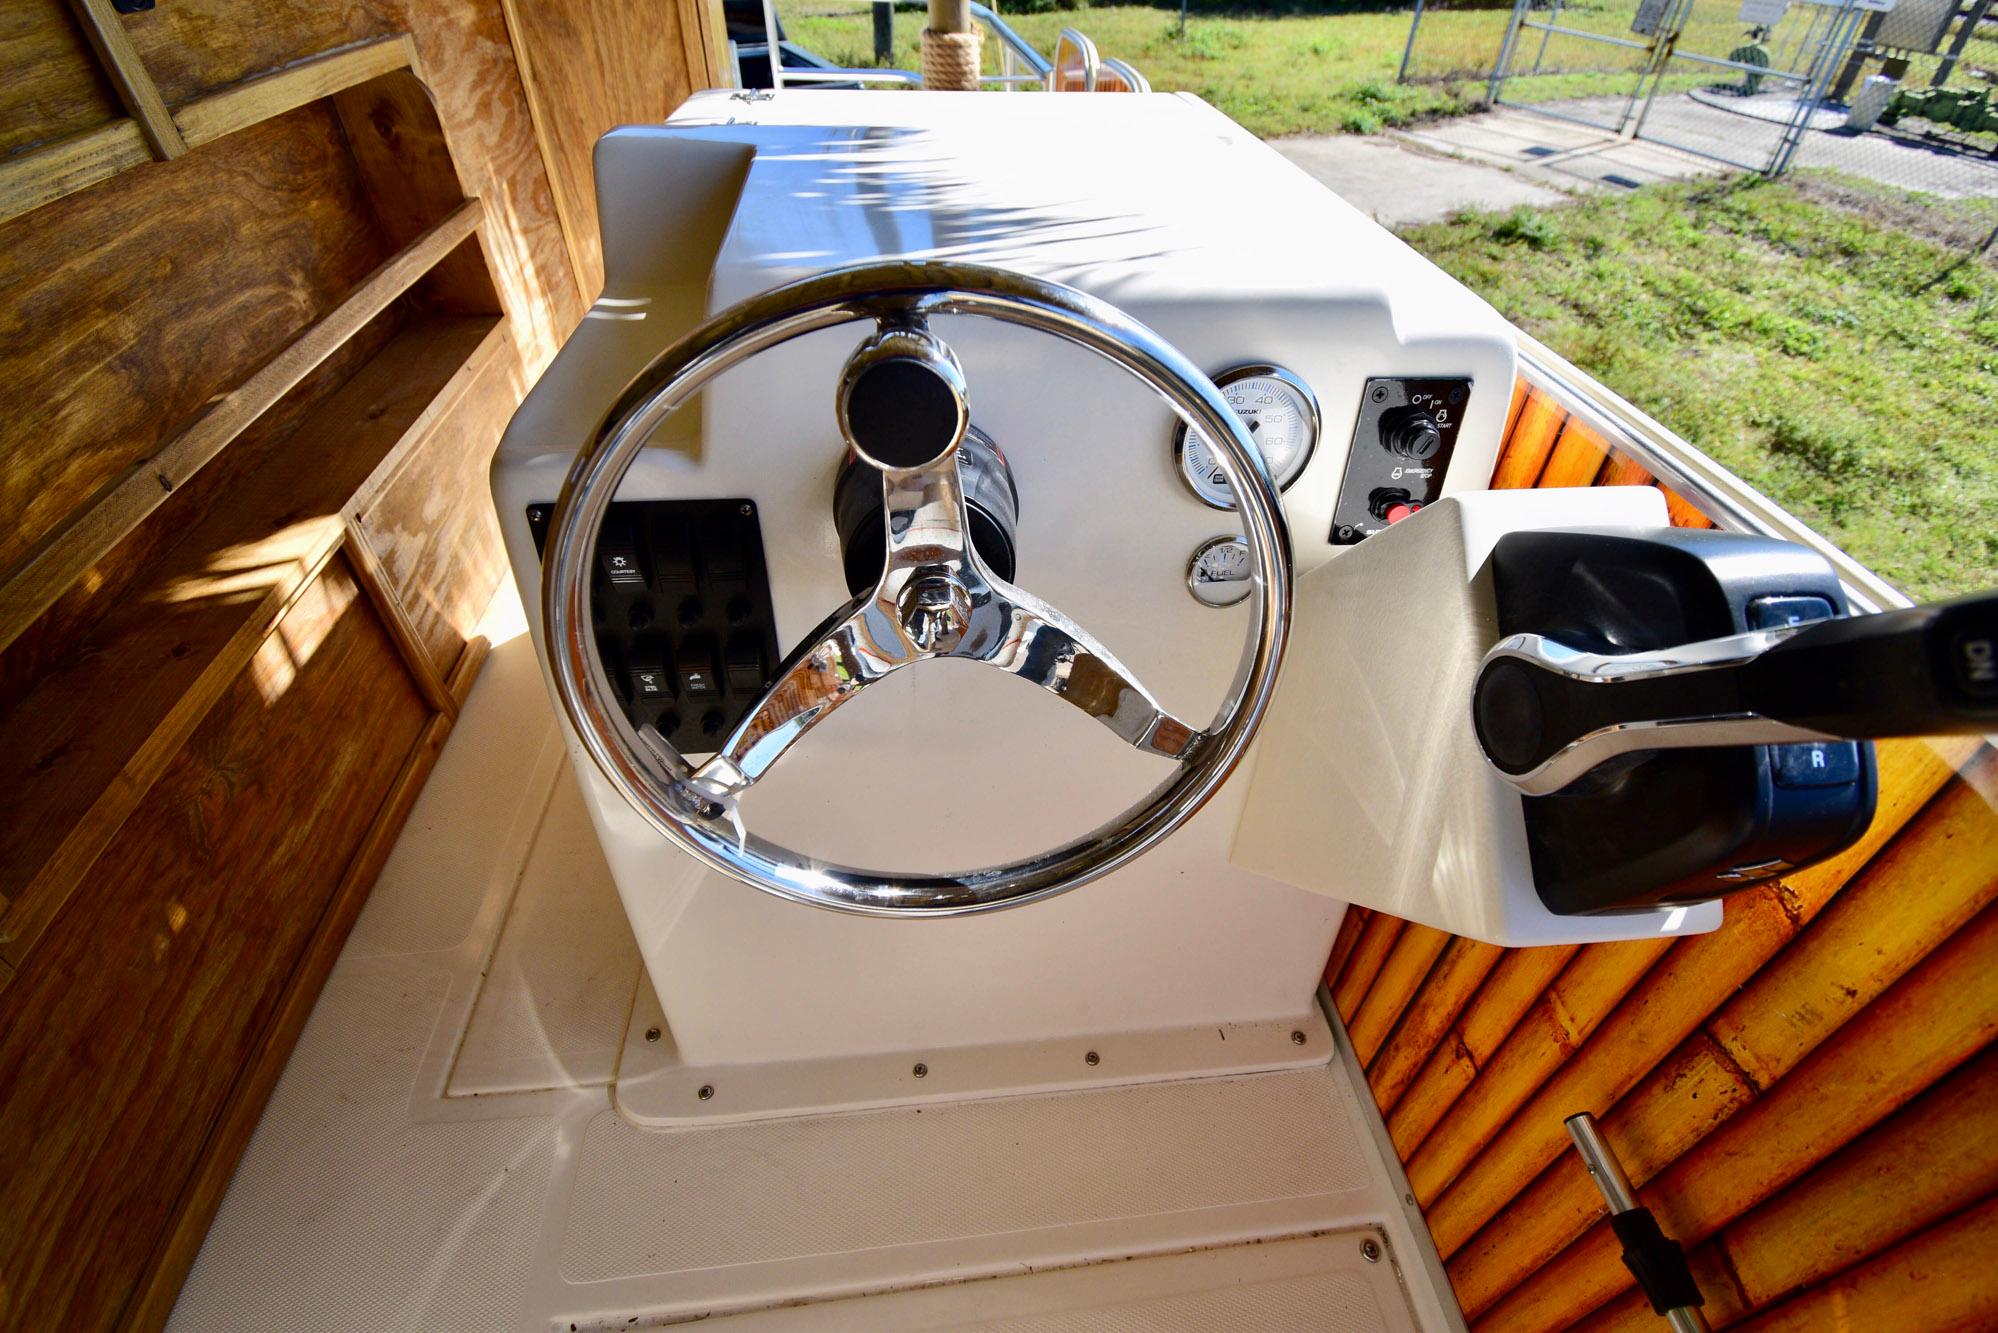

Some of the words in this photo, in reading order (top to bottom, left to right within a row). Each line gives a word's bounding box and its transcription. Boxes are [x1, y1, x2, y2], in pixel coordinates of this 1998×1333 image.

[1228, 396, 1244, 404] 30
[1255, 396, 1273, 404] 40
[1265, 415, 1282, 423] 50
[1265, 437, 1283, 445] 60
[1811, 750, 1825, 768] R
